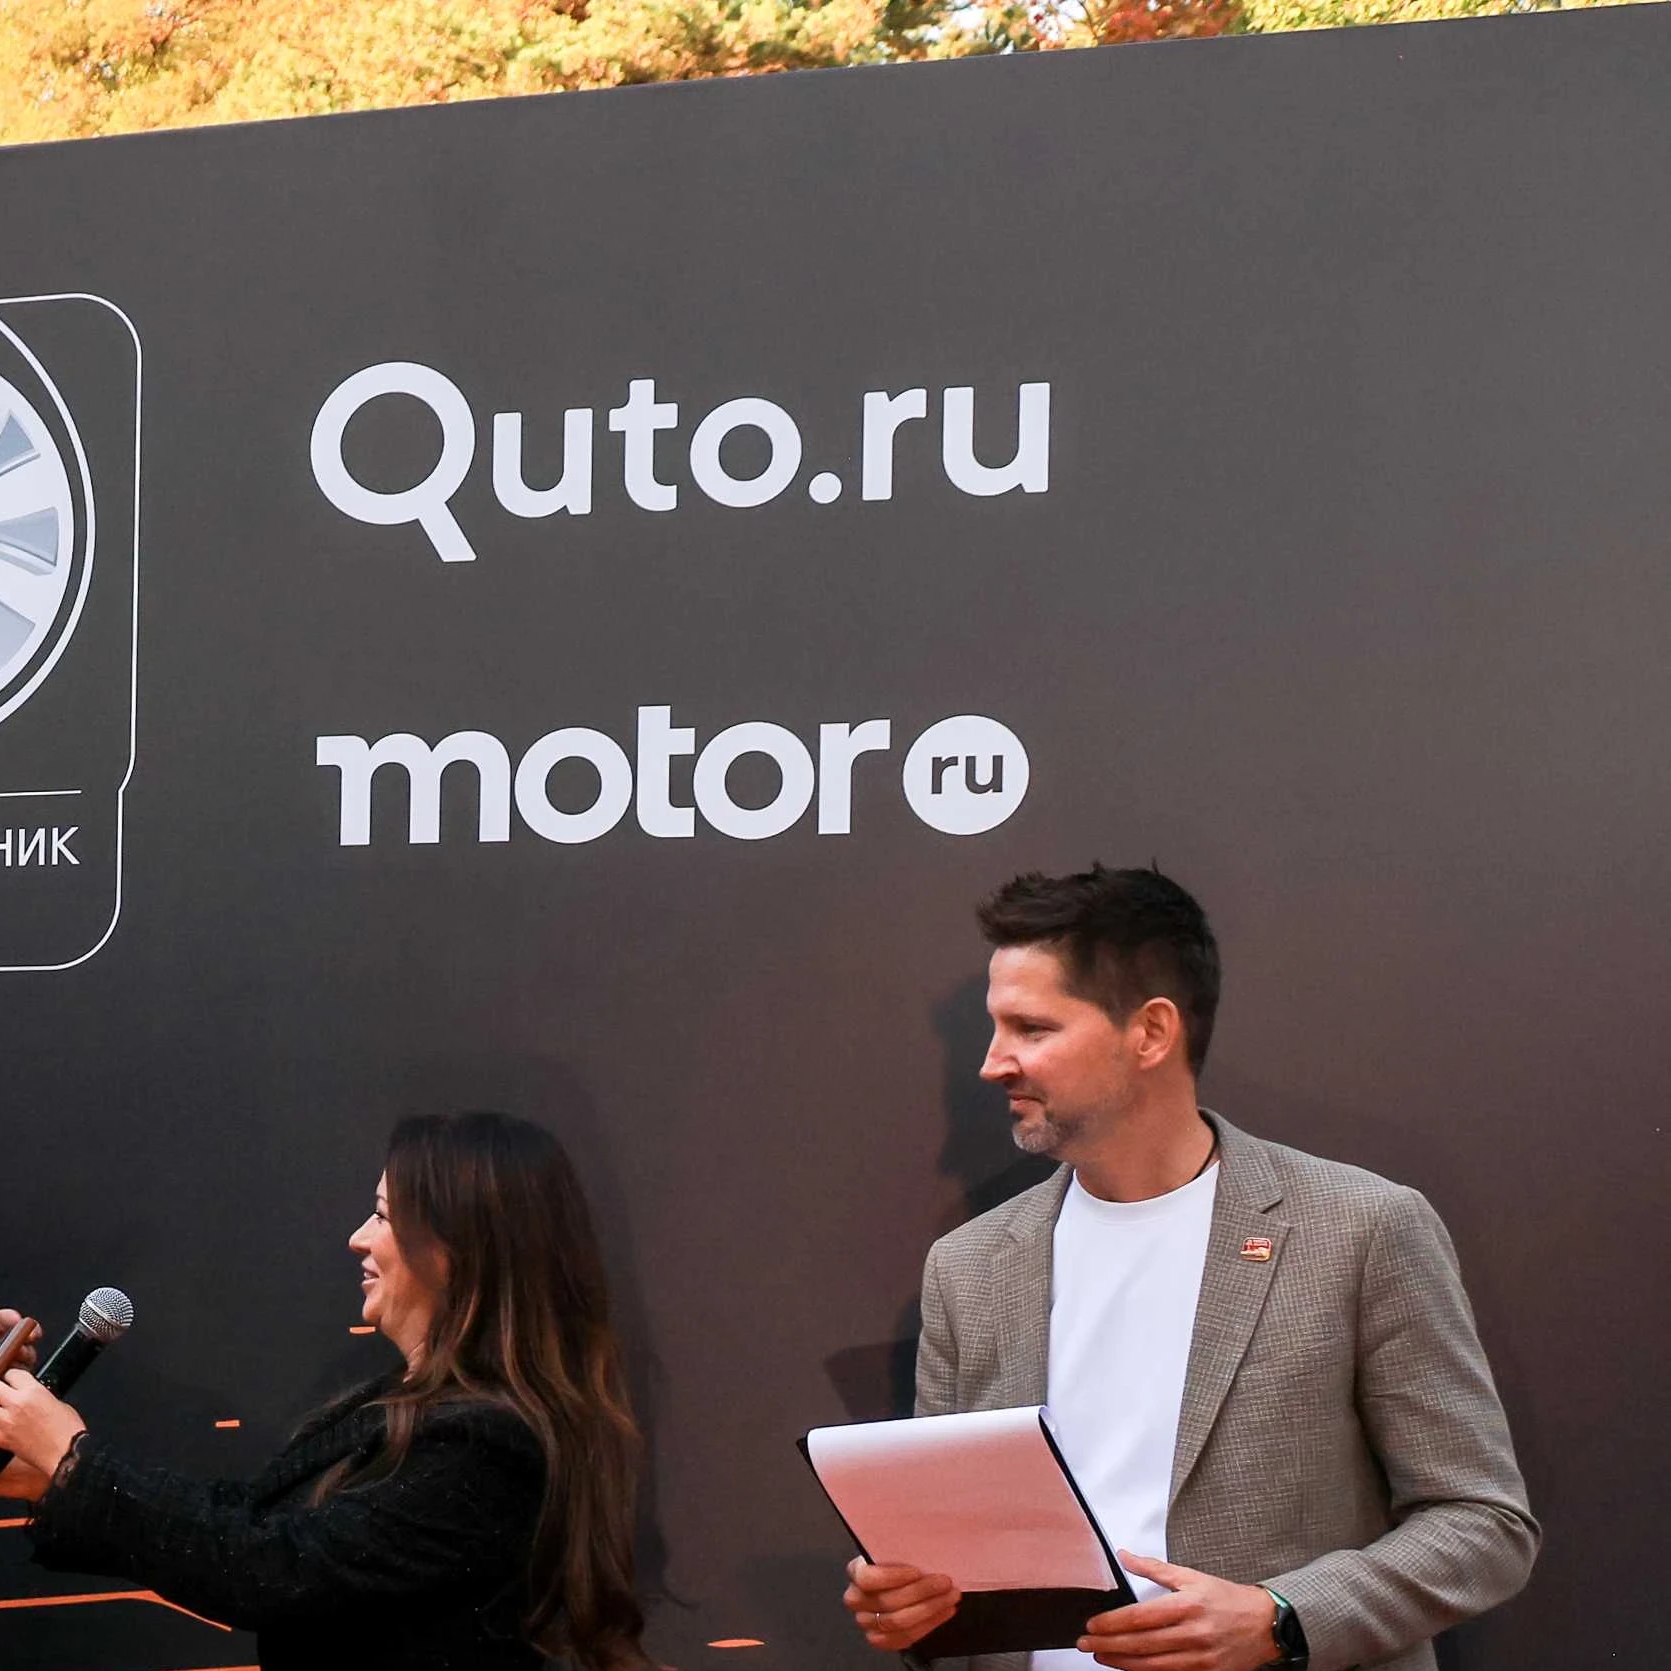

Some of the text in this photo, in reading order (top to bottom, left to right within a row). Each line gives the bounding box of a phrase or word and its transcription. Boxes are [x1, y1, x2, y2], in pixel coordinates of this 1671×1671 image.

[309, 361, 1052, 563] Quto.ru
[315, 704, 1005, 846] motor ru
